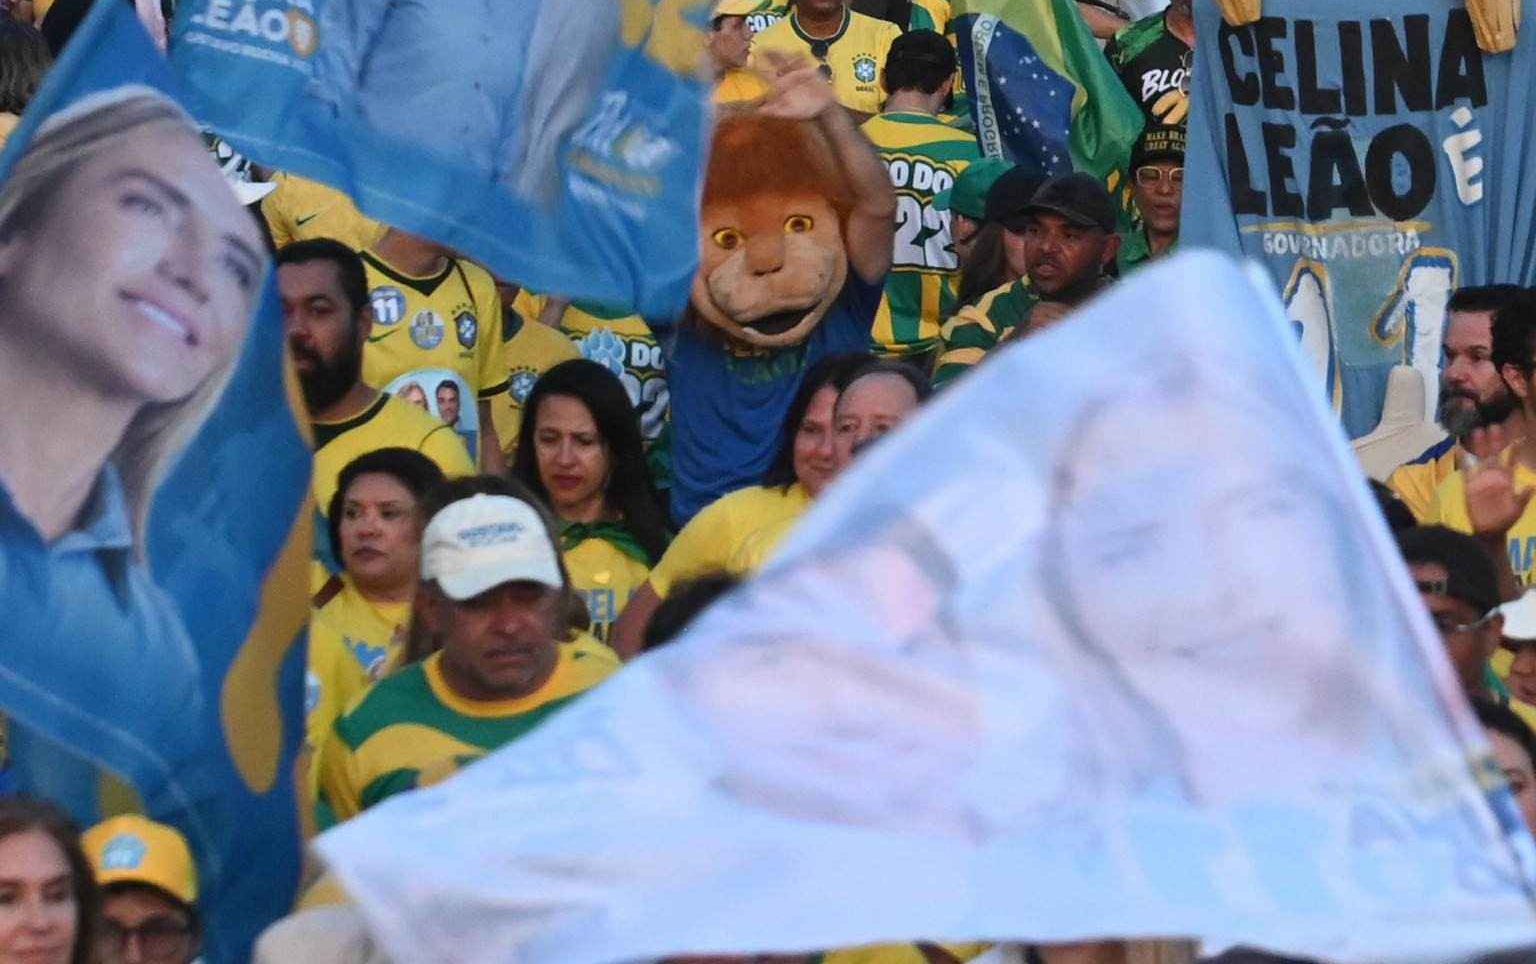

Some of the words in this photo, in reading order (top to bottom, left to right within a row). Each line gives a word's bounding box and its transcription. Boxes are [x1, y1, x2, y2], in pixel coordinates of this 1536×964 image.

[1218, 7, 1488, 117] CELINA
[978, 89, 999, 161] PROGR
[913, 161, 954, 194] DO
[1224, 113, 1436, 223] LEÃO
[1443, 105, 1485, 206] É
[893, 194, 959, 270] 22
[373, 298, 401, 323] 11
